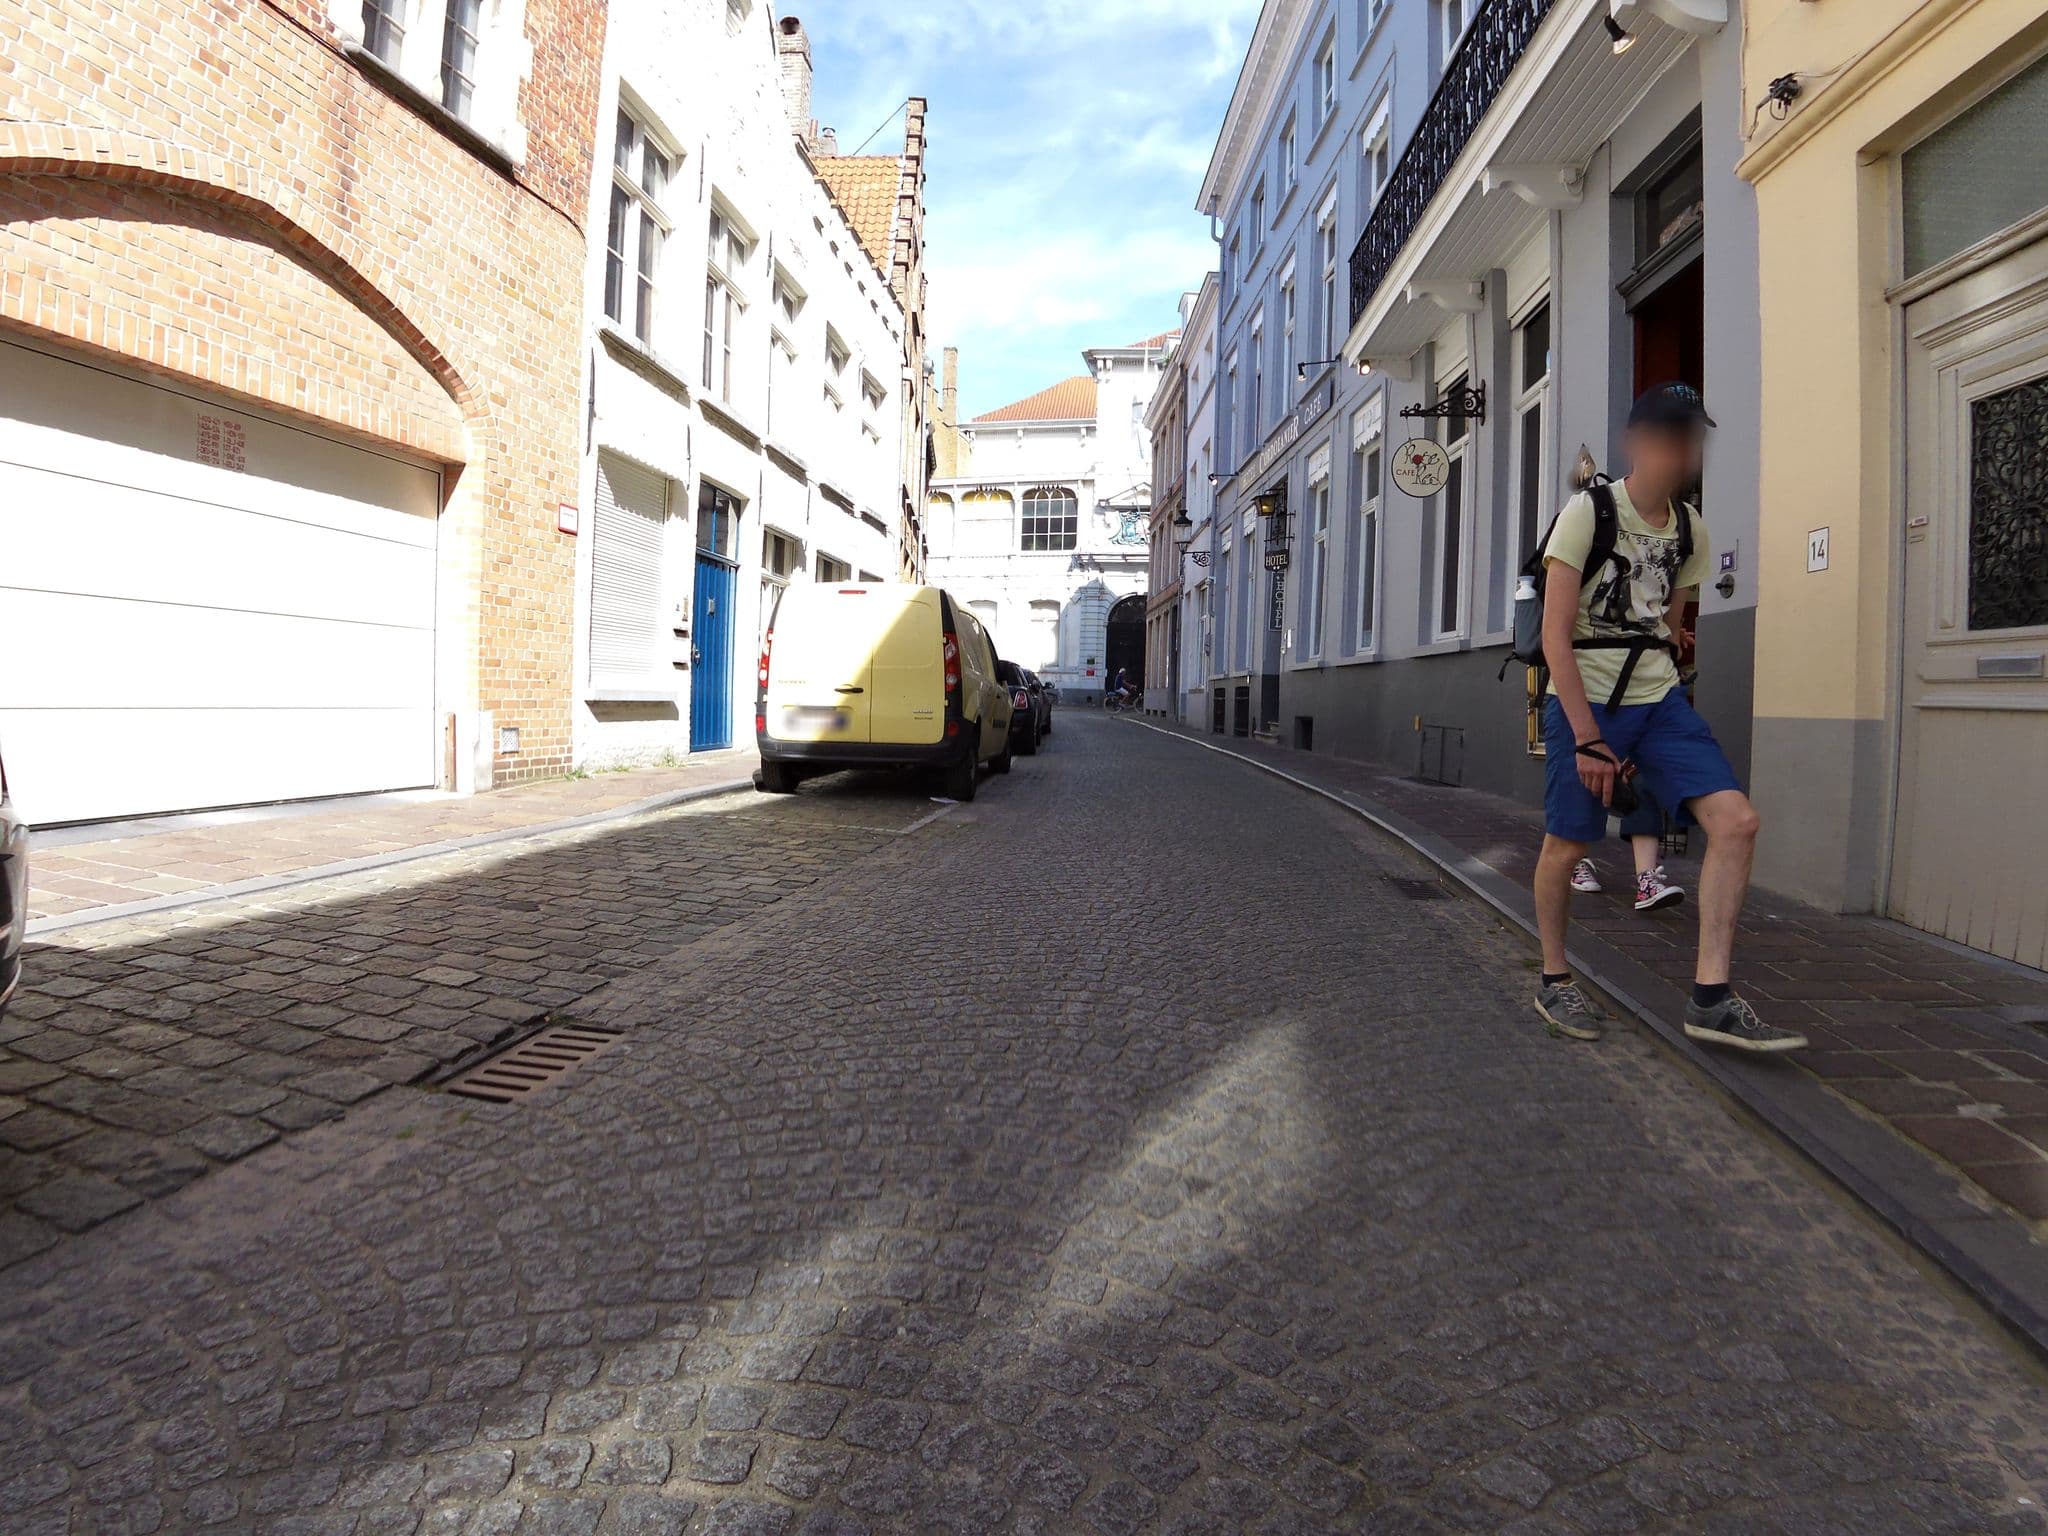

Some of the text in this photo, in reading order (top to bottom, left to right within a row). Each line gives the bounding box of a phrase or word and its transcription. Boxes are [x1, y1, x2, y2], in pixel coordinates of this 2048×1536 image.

[1265, 554, 1288, 567] HOTEL
[1811, 539, 1825, 561] 14
[1275, 581, 1285, 629] HOTEL
